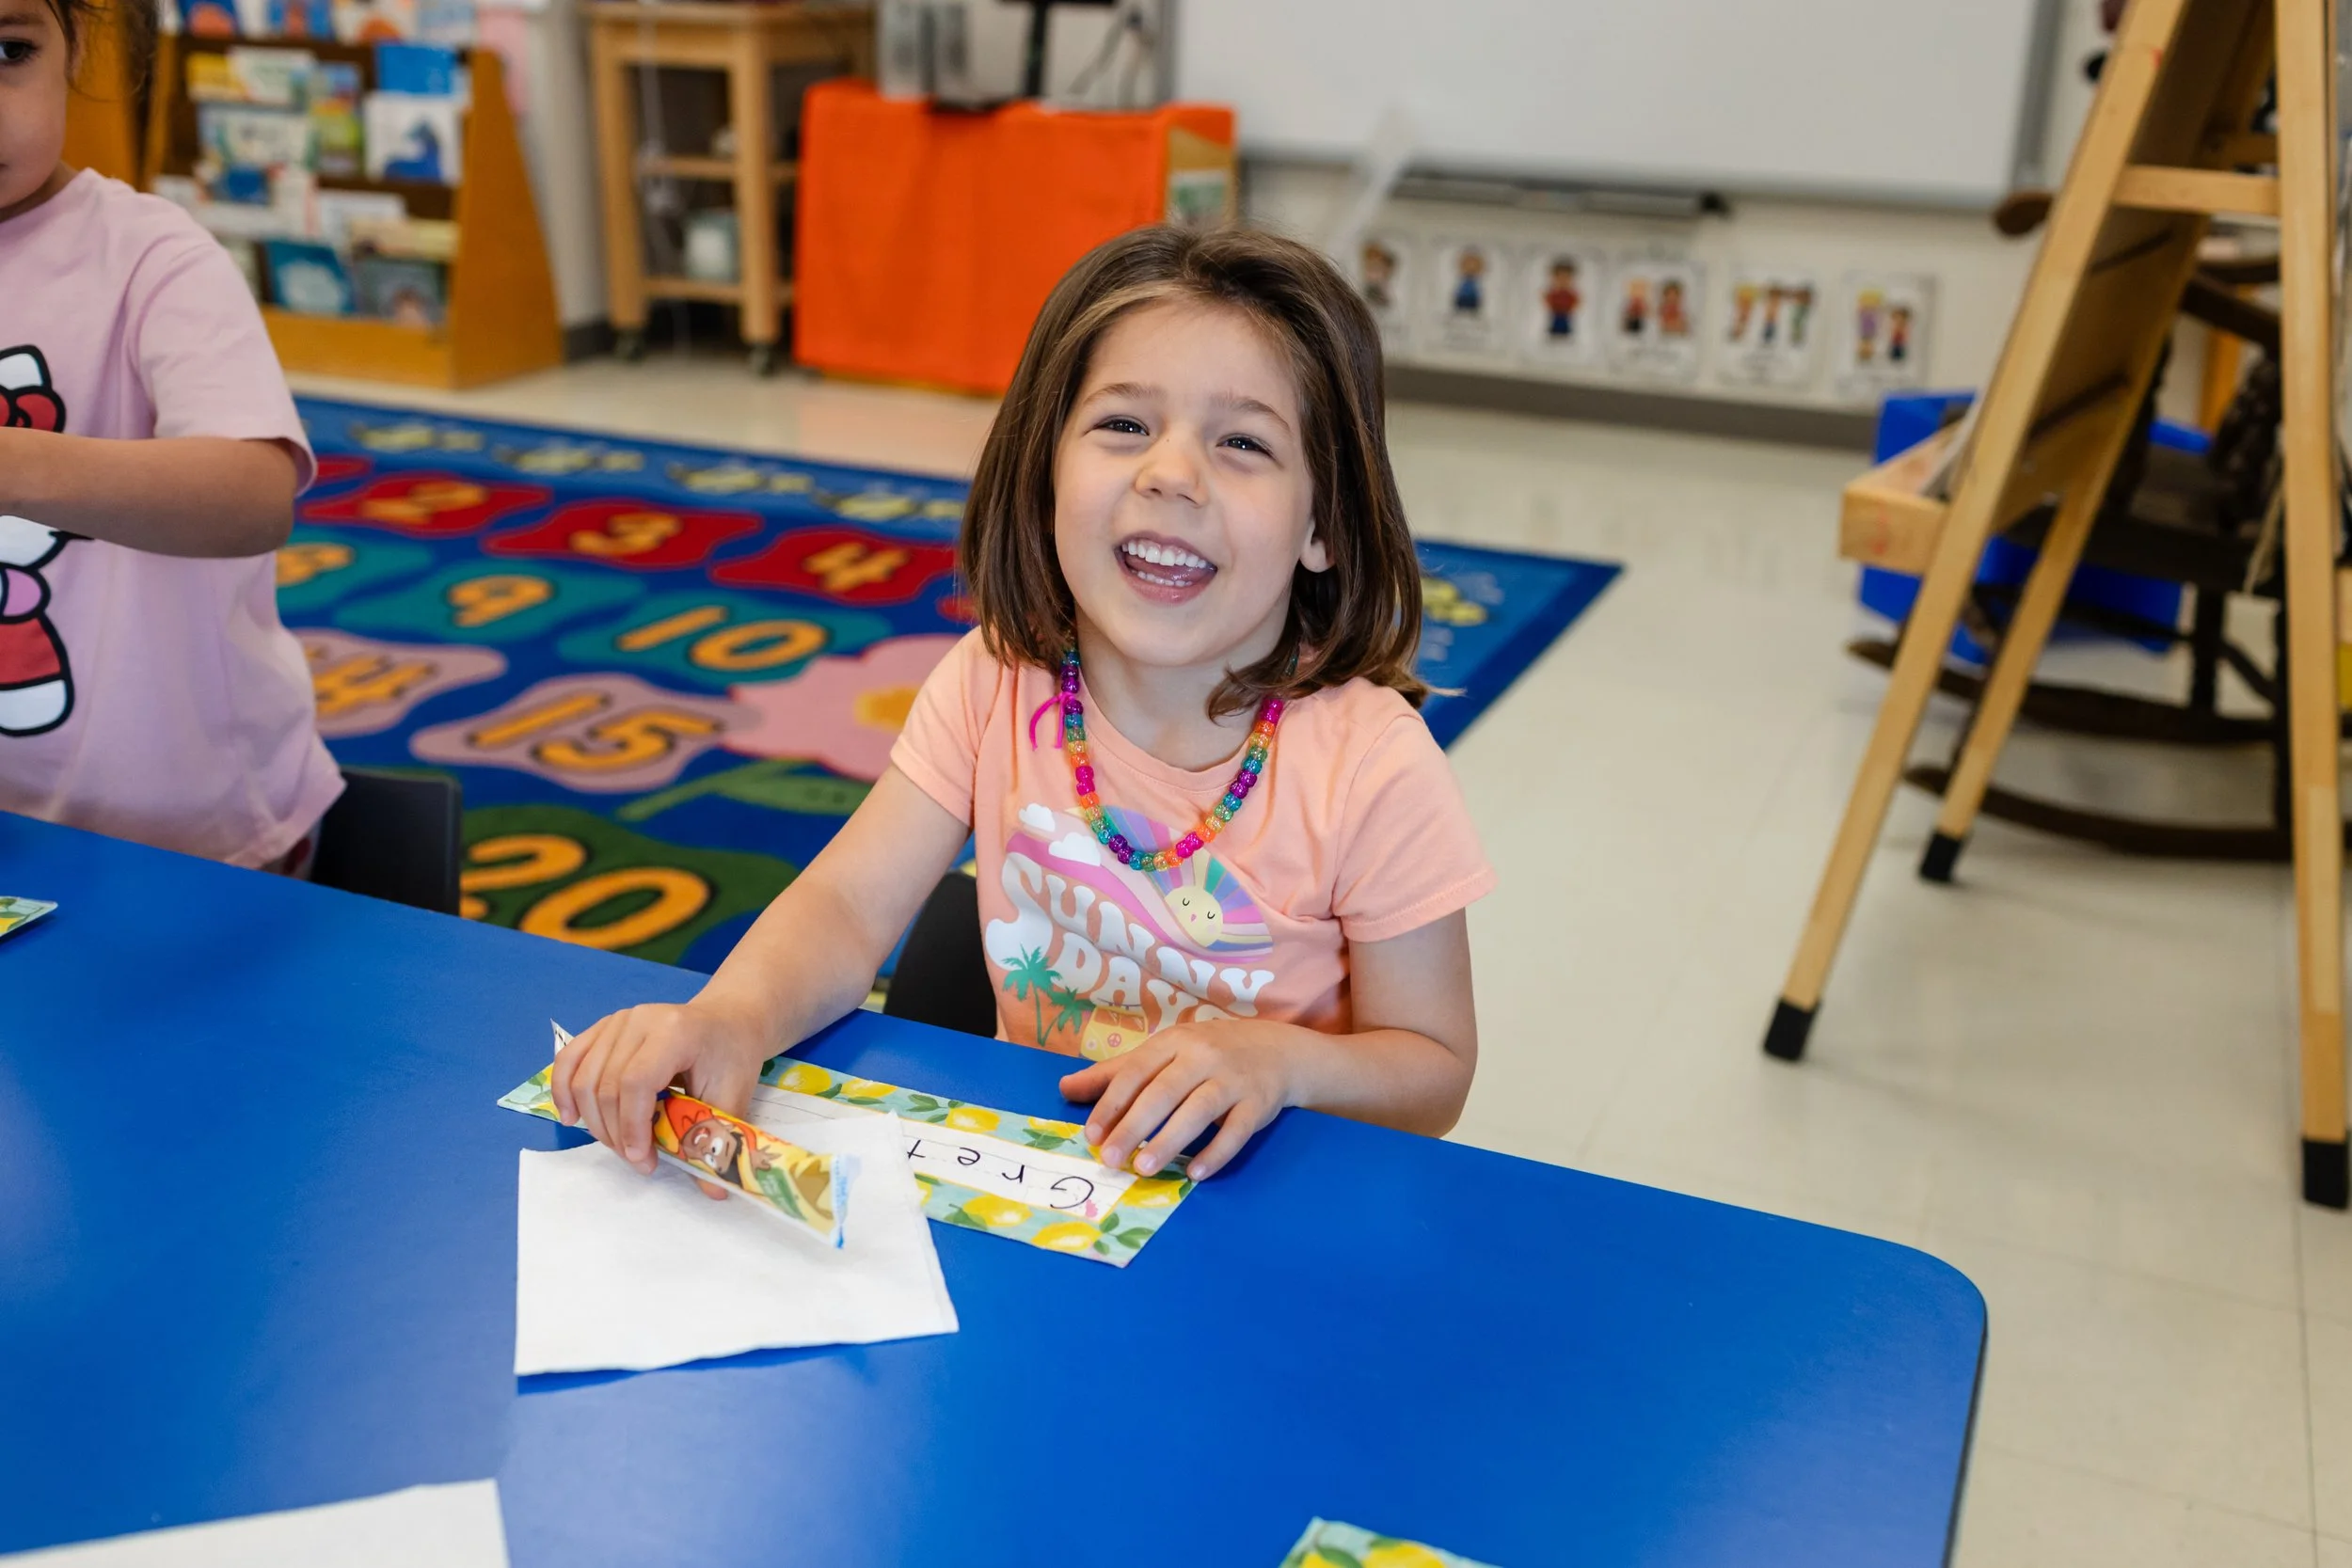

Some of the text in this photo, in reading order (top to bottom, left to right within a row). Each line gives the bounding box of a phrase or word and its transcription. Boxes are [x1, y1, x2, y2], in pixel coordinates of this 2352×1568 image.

[360, 483, 485, 526] 2
[569, 513, 681, 557] 3
[805, 542, 912, 593] 4
[449, 575, 552, 626] 9
[617, 605, 827, 671] 10
[470, 691, 724, 771] 15
[460, 833, 708, 950] 20
[985, 852, 1275, 1017] SUNNY
